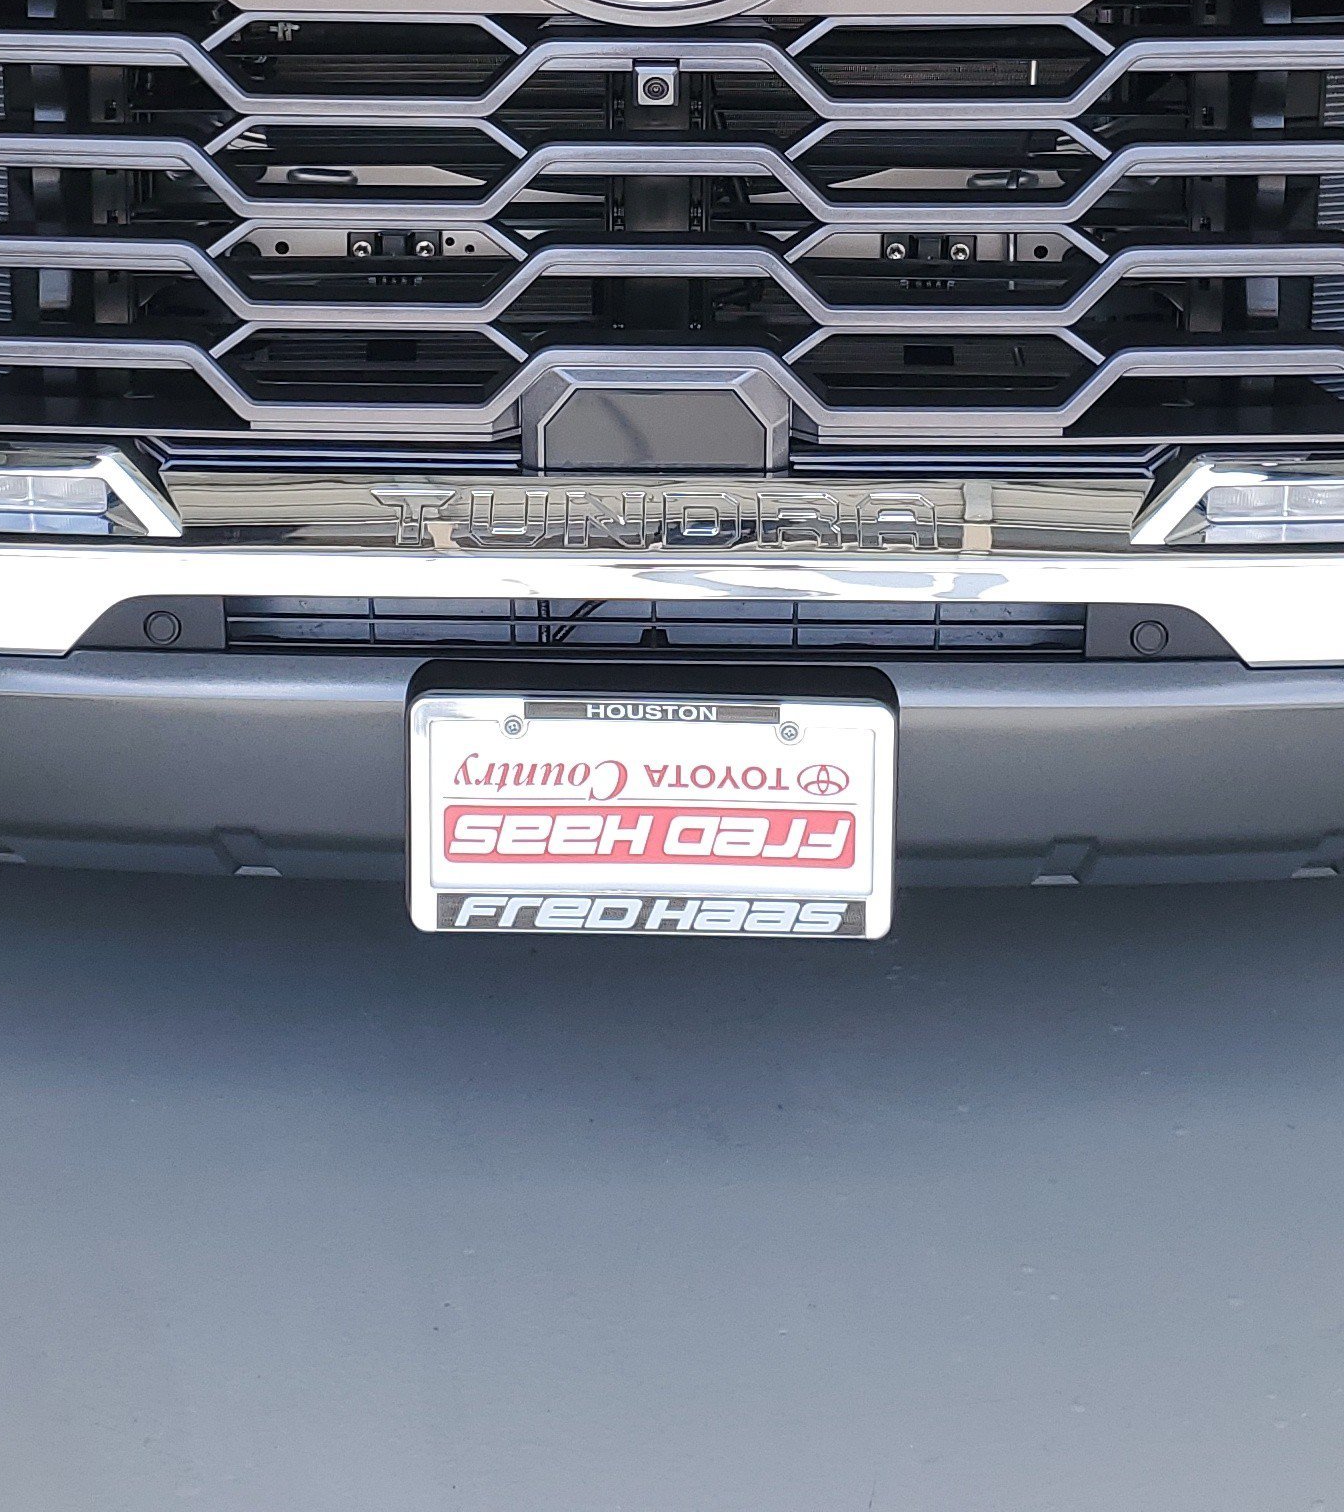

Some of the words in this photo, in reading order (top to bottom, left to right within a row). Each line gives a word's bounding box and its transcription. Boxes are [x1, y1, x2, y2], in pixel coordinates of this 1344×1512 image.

[369, 488, 939, 549] TUNDRA
[586, 703, 718, 721] HOUSTON
[453, 752, 629, 801] Country
[644, 764, 790, 791] TOYOTA
